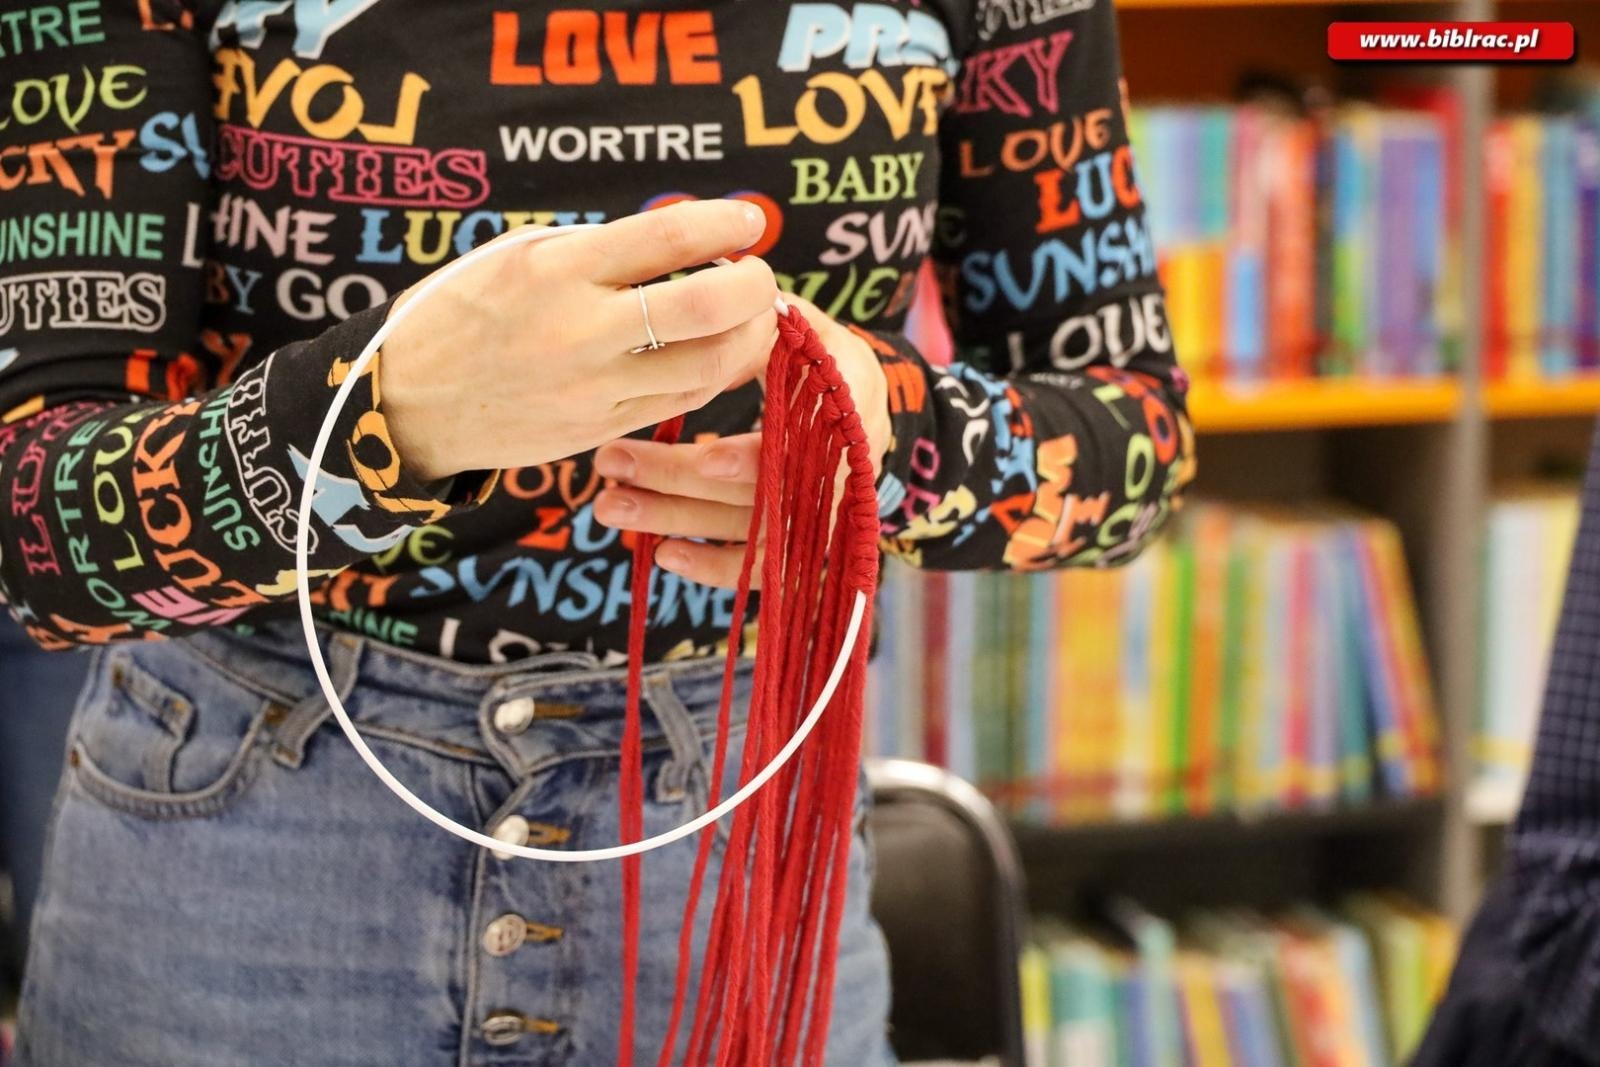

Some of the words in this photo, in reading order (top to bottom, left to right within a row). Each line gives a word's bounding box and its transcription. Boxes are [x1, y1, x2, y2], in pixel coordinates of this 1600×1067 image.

[490, 9, 722, 85] LOVE
[499, 124, 724, 162] WORTRE
[960, 108, 1113, 178] LOVE
[790, 152, 924, 205] BABY
[355, 209, 606, 265] LUC
